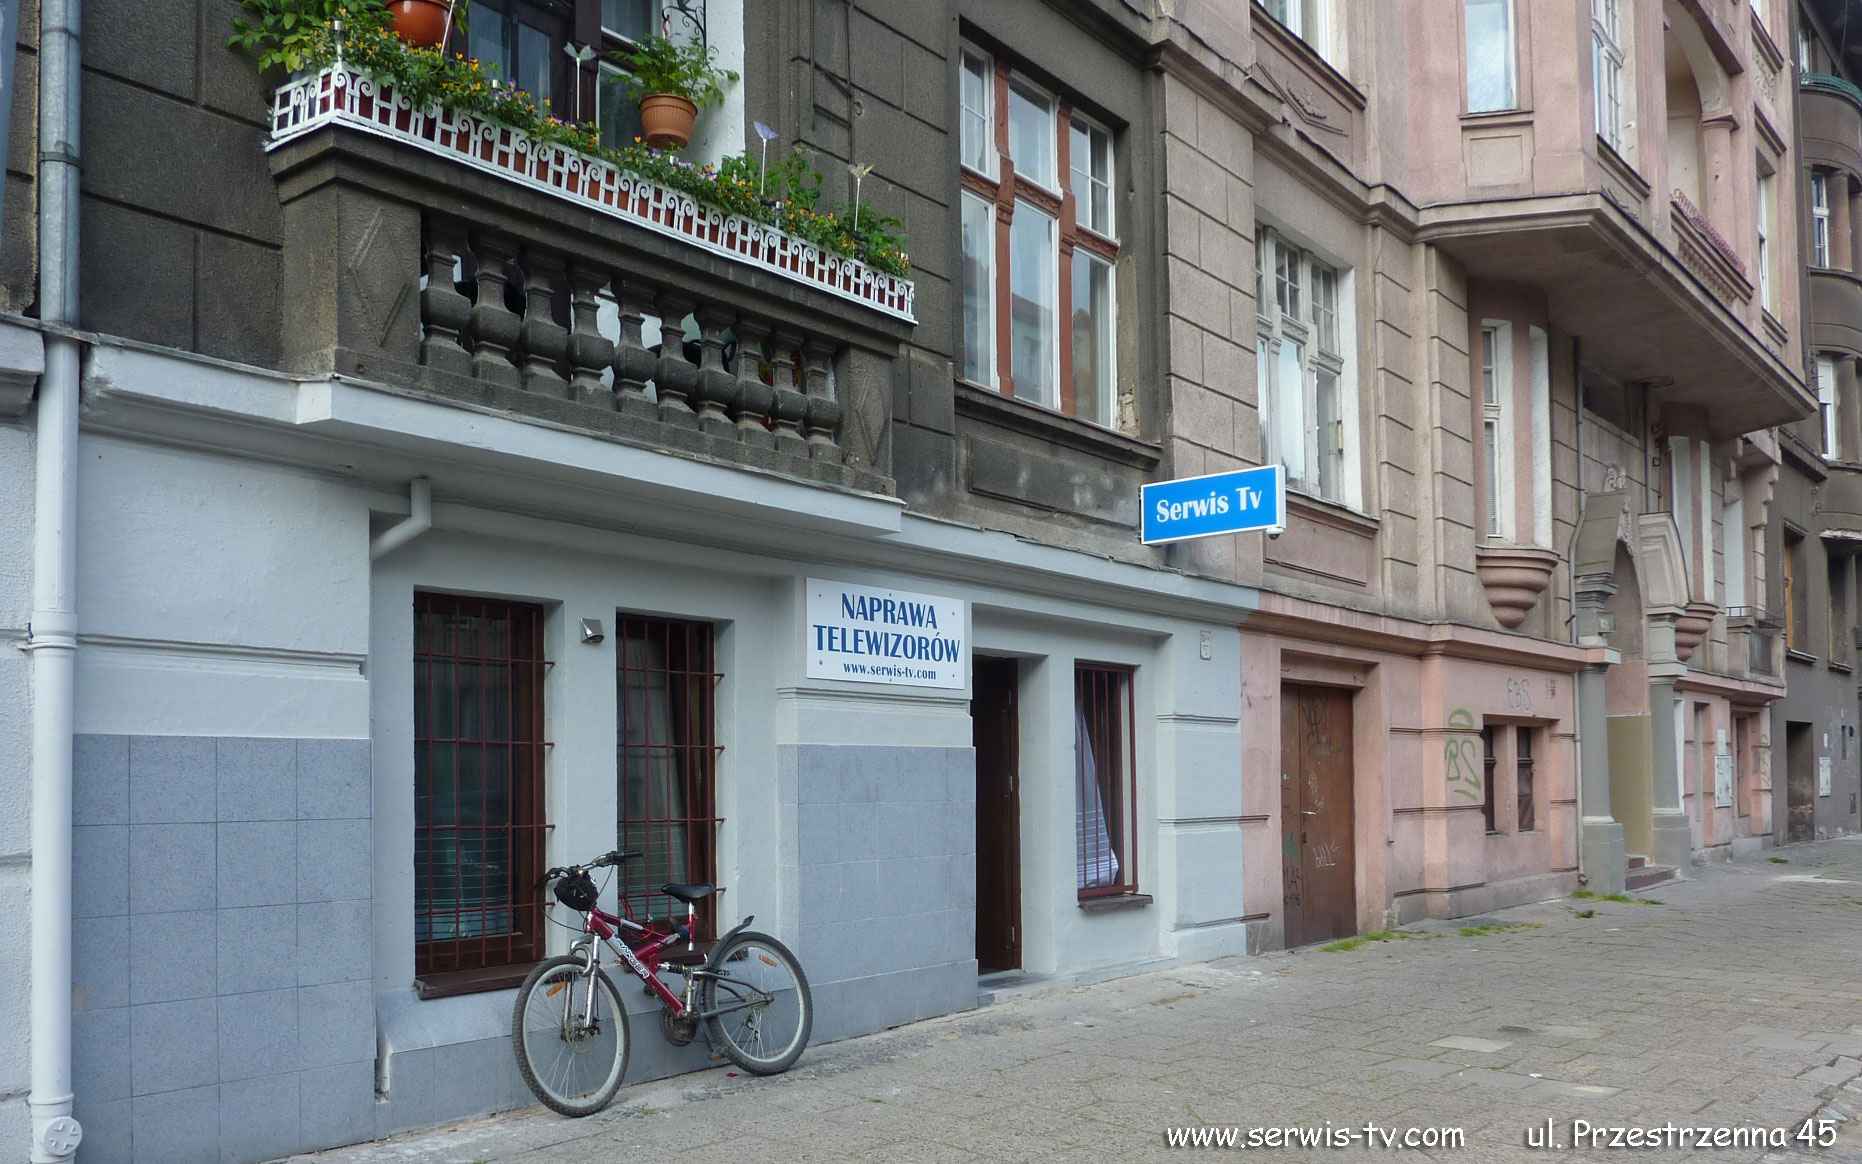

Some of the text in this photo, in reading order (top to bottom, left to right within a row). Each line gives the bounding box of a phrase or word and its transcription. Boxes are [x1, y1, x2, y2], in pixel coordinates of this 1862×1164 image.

[1156, 486, 1263, 523] Serwis Tv
[841, 592, 938, 630] NAPRAWA
[813, 624, 960, 663] TELEWIZORÓW
[843, 662, 937, 681] www.serwis-tv.com
